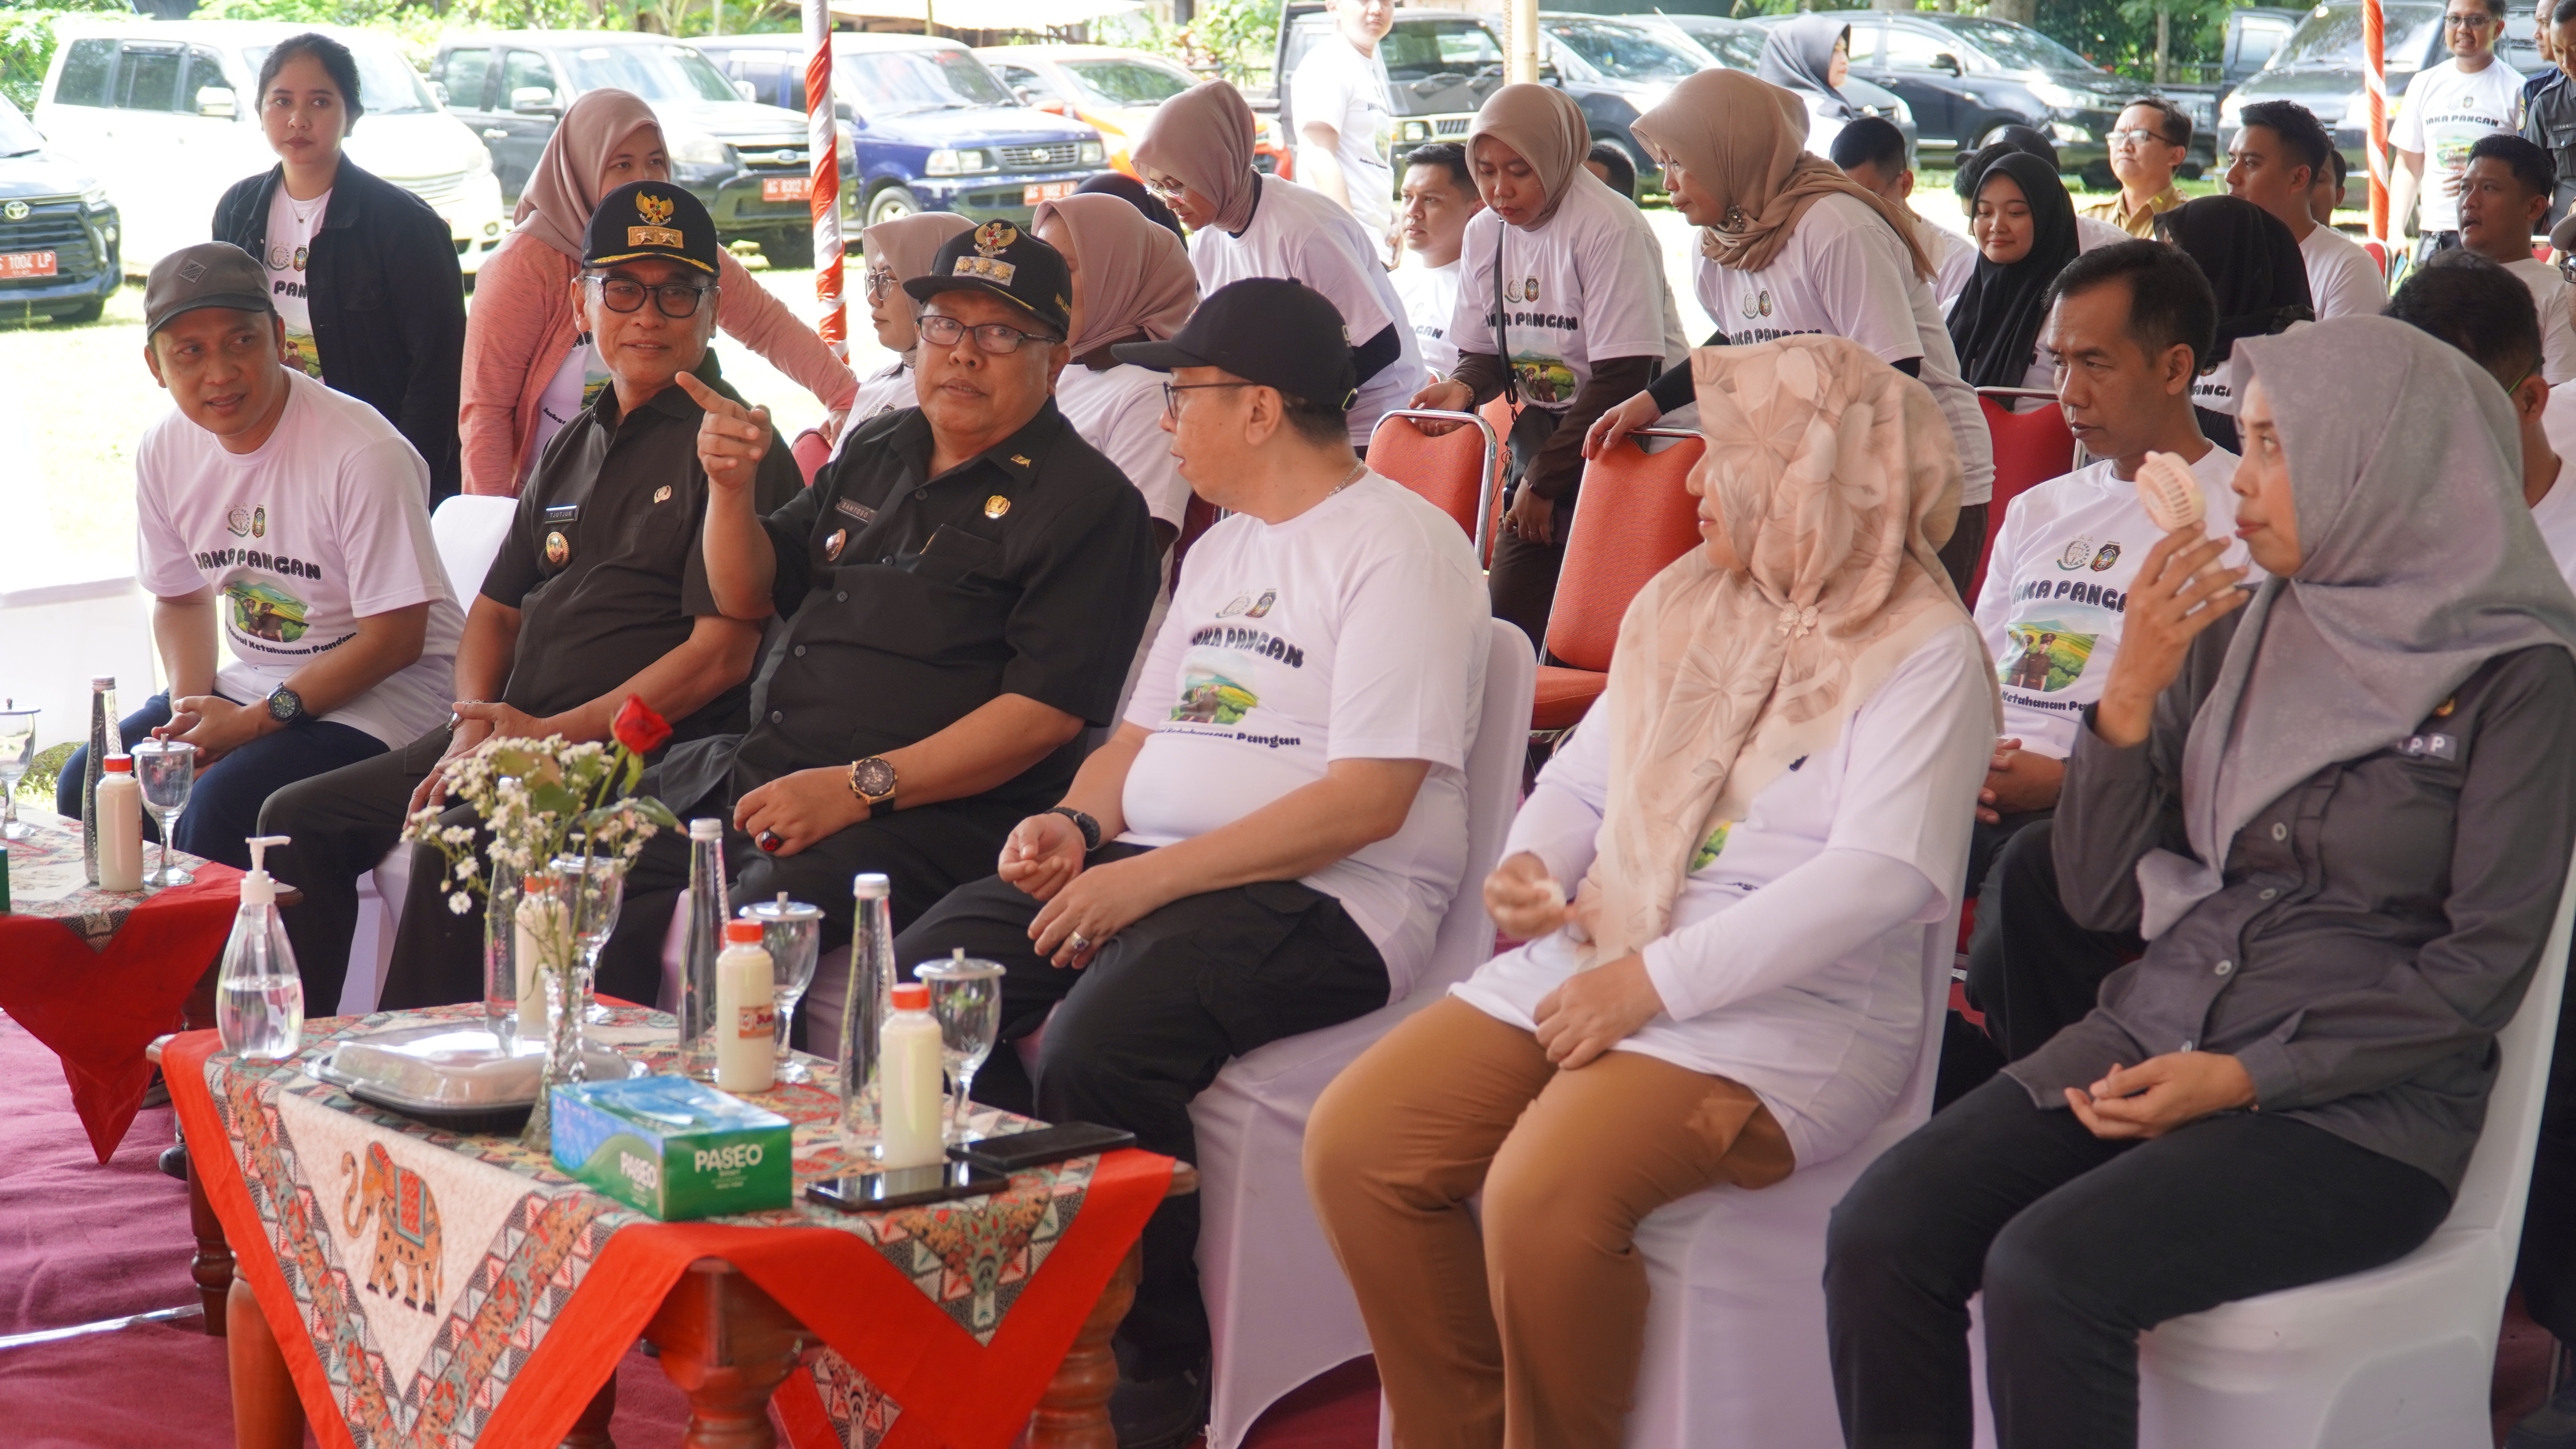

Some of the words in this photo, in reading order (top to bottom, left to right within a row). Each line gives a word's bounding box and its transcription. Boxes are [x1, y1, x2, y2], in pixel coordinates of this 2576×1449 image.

[2451, 115, 2499, 128] PANGAN
[767, 180, 778, 193] AG
[38, 252, 52, 267] LP
[1516, 312, 1578, 330] PANGAN
[842, 502, 869, 518] SANTOSO
[195, 548, 235, 570] JAKA
[237, 549, 321, 580] PANGAN
[249, 640, 312, 655] Ketahanan
[1224, 627, 1304, 668] PANGAN
[2002, 690, 2067, 710] Ketahanan
[1236, 732, 1301, 748] Pangan
[694, 1143, 763, 1173] PASEO
[620, 1151, 657, 1190] PASEO
